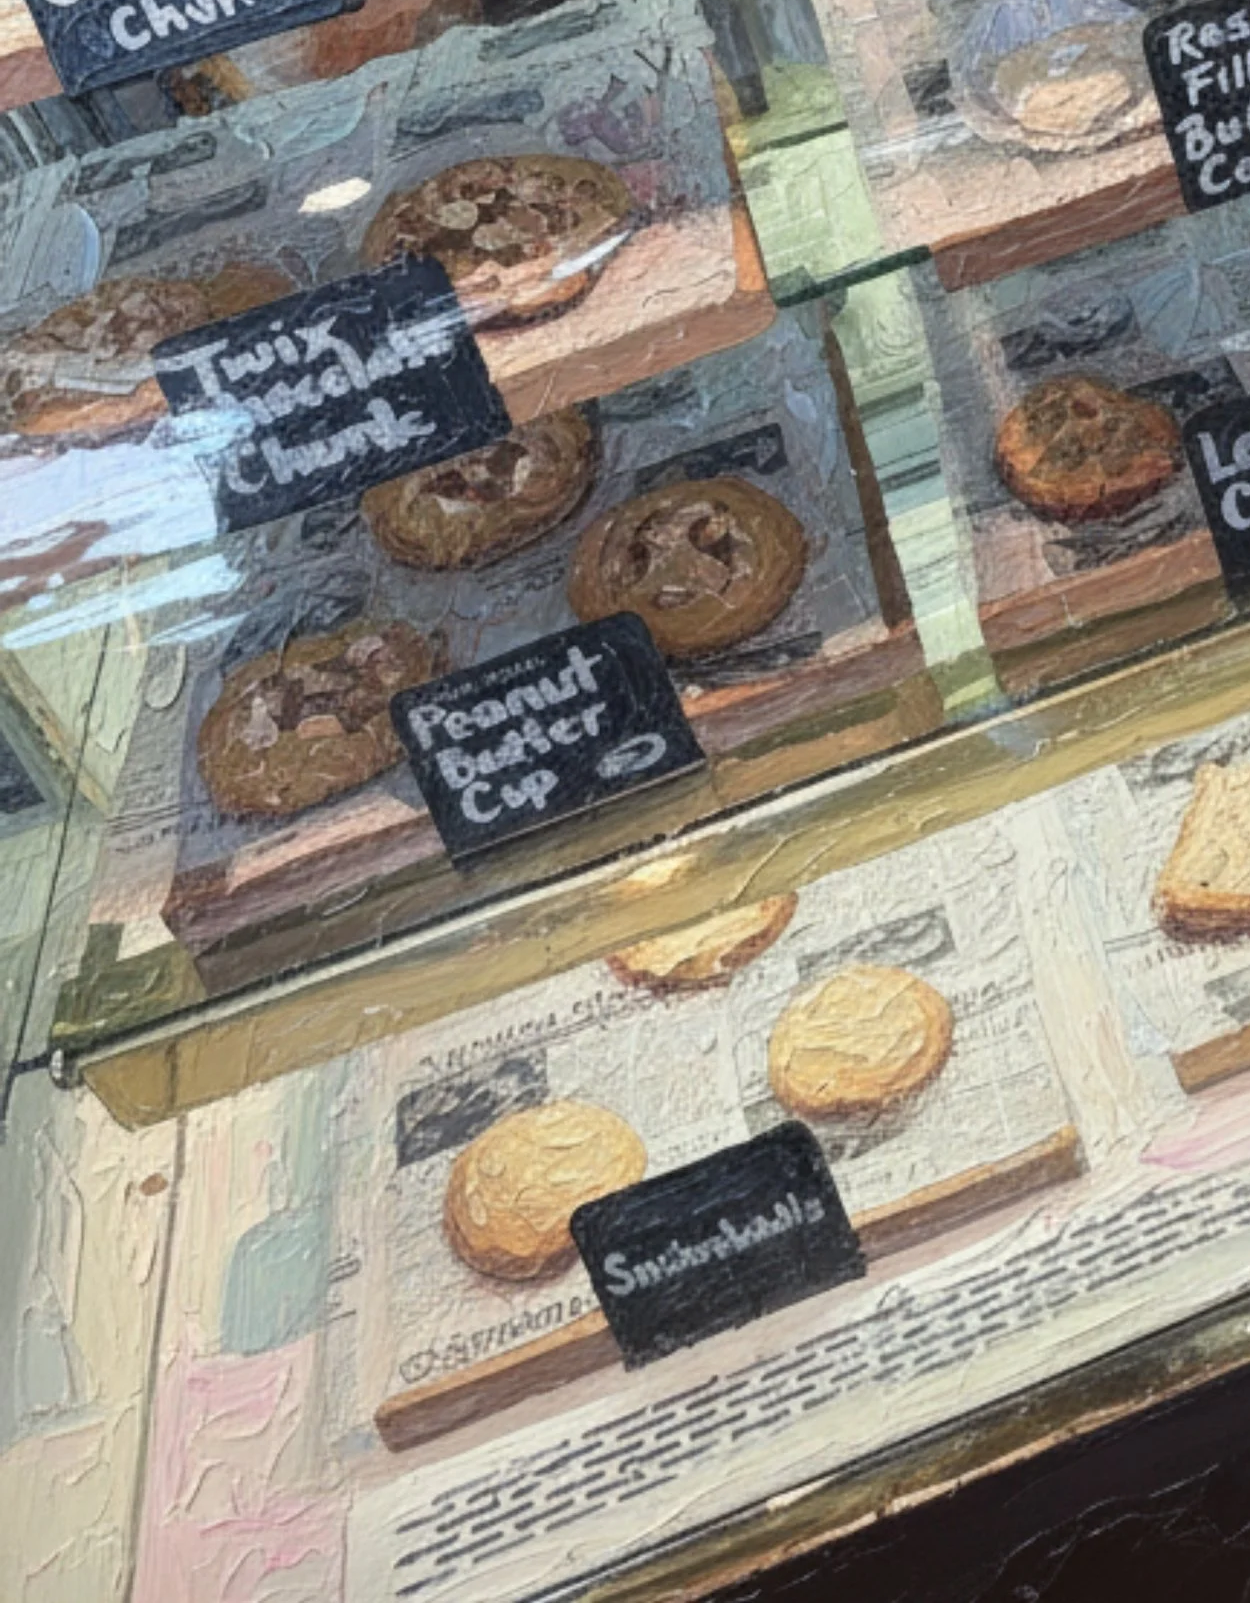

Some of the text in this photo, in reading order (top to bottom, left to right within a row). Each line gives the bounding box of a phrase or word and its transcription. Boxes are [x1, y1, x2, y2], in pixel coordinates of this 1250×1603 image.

[406, 645, 604, 752] Peanut
[434, 700, 608, 790] Butter
[460, 768, 560, 825] Cup
